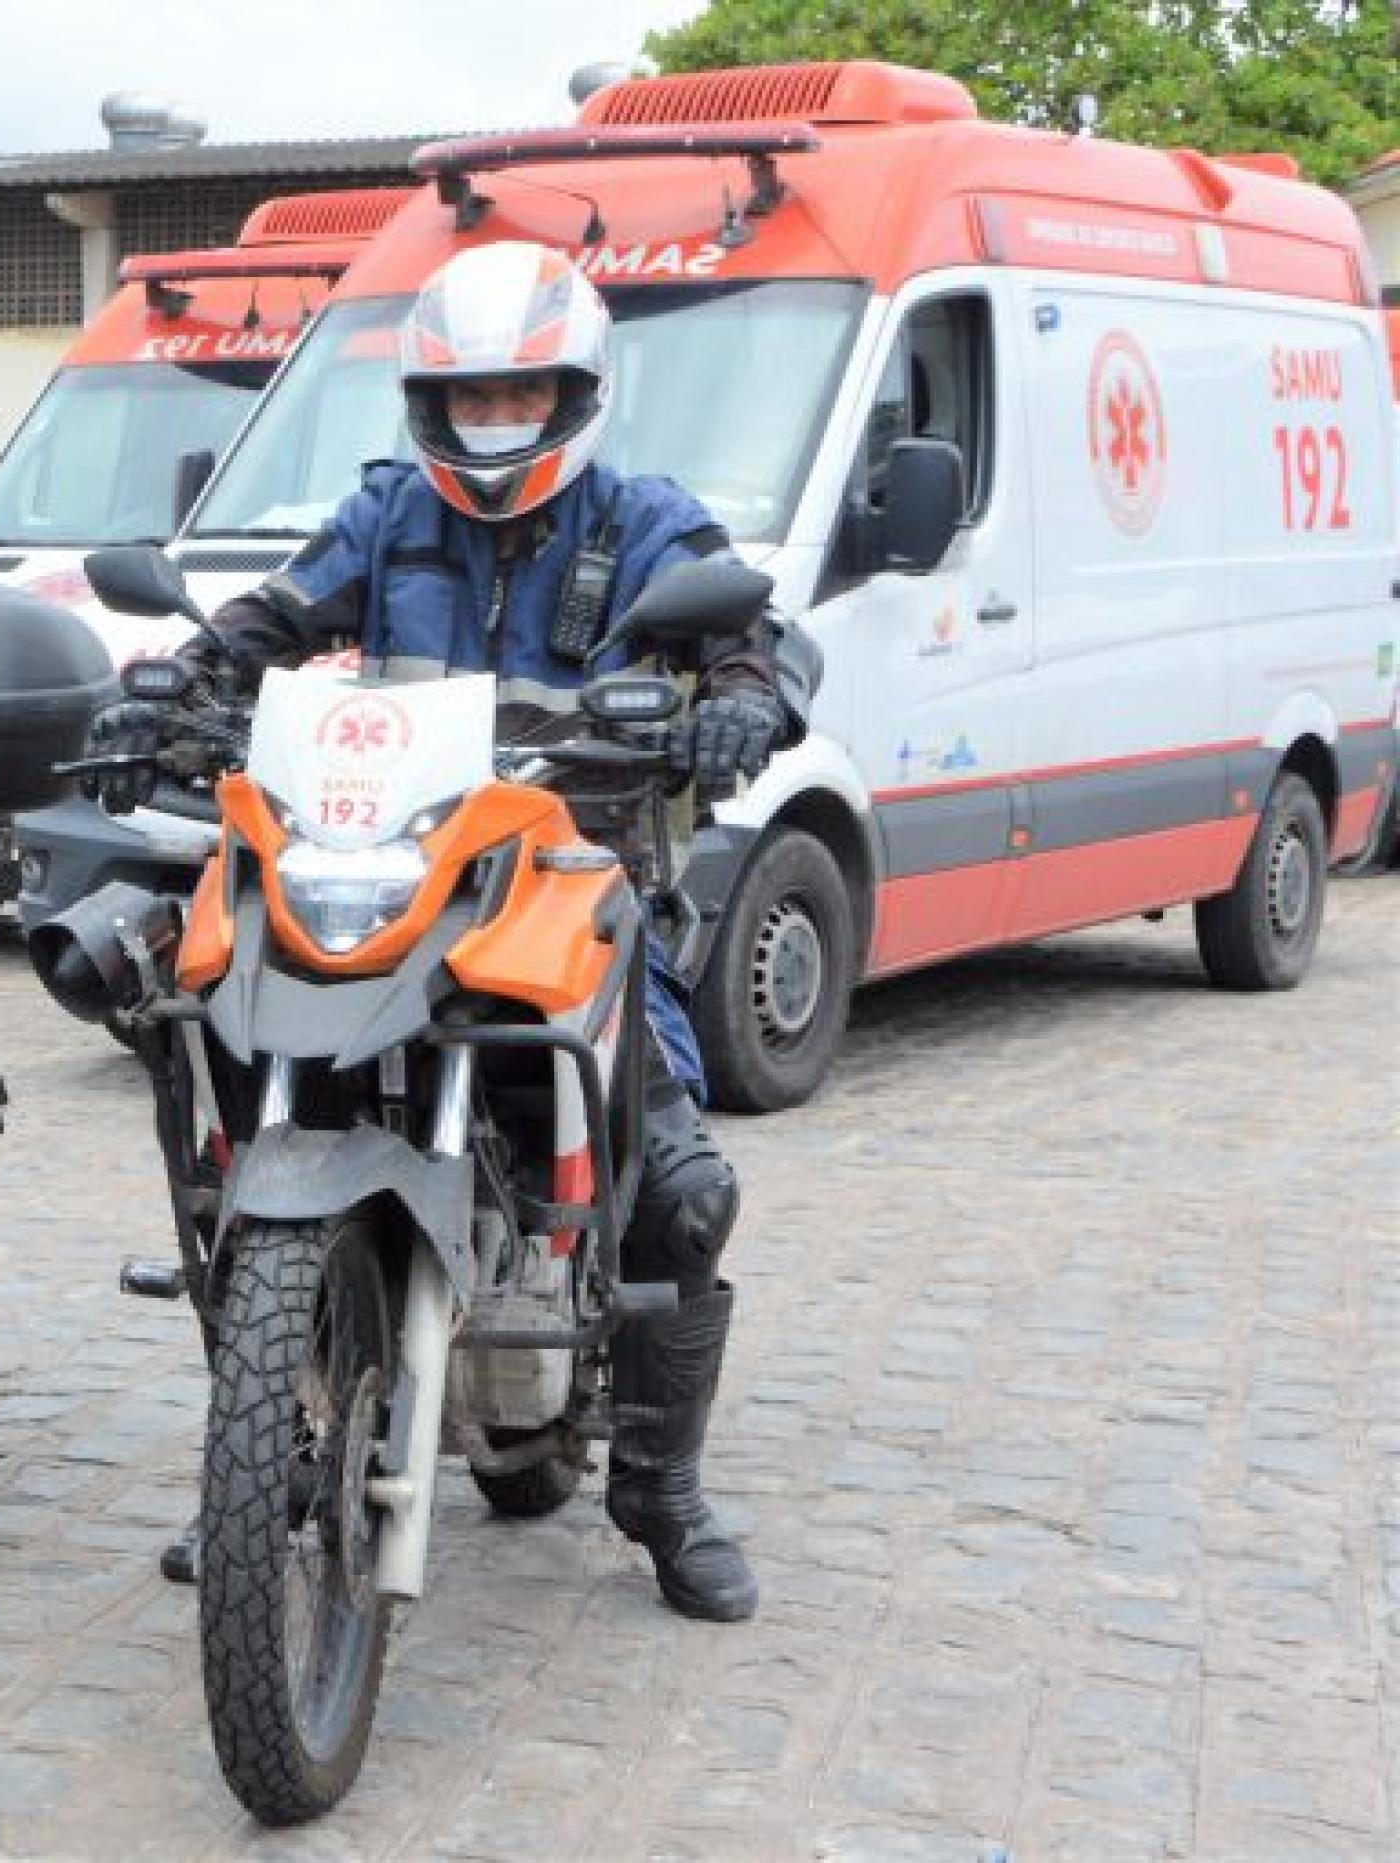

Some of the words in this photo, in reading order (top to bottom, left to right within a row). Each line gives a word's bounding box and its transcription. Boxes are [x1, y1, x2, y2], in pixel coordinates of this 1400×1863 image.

[1270, 345, 1342, 400] SAMU
[1273, 425, 1351, 531] 192
[319, 798, 378, 825] 192
